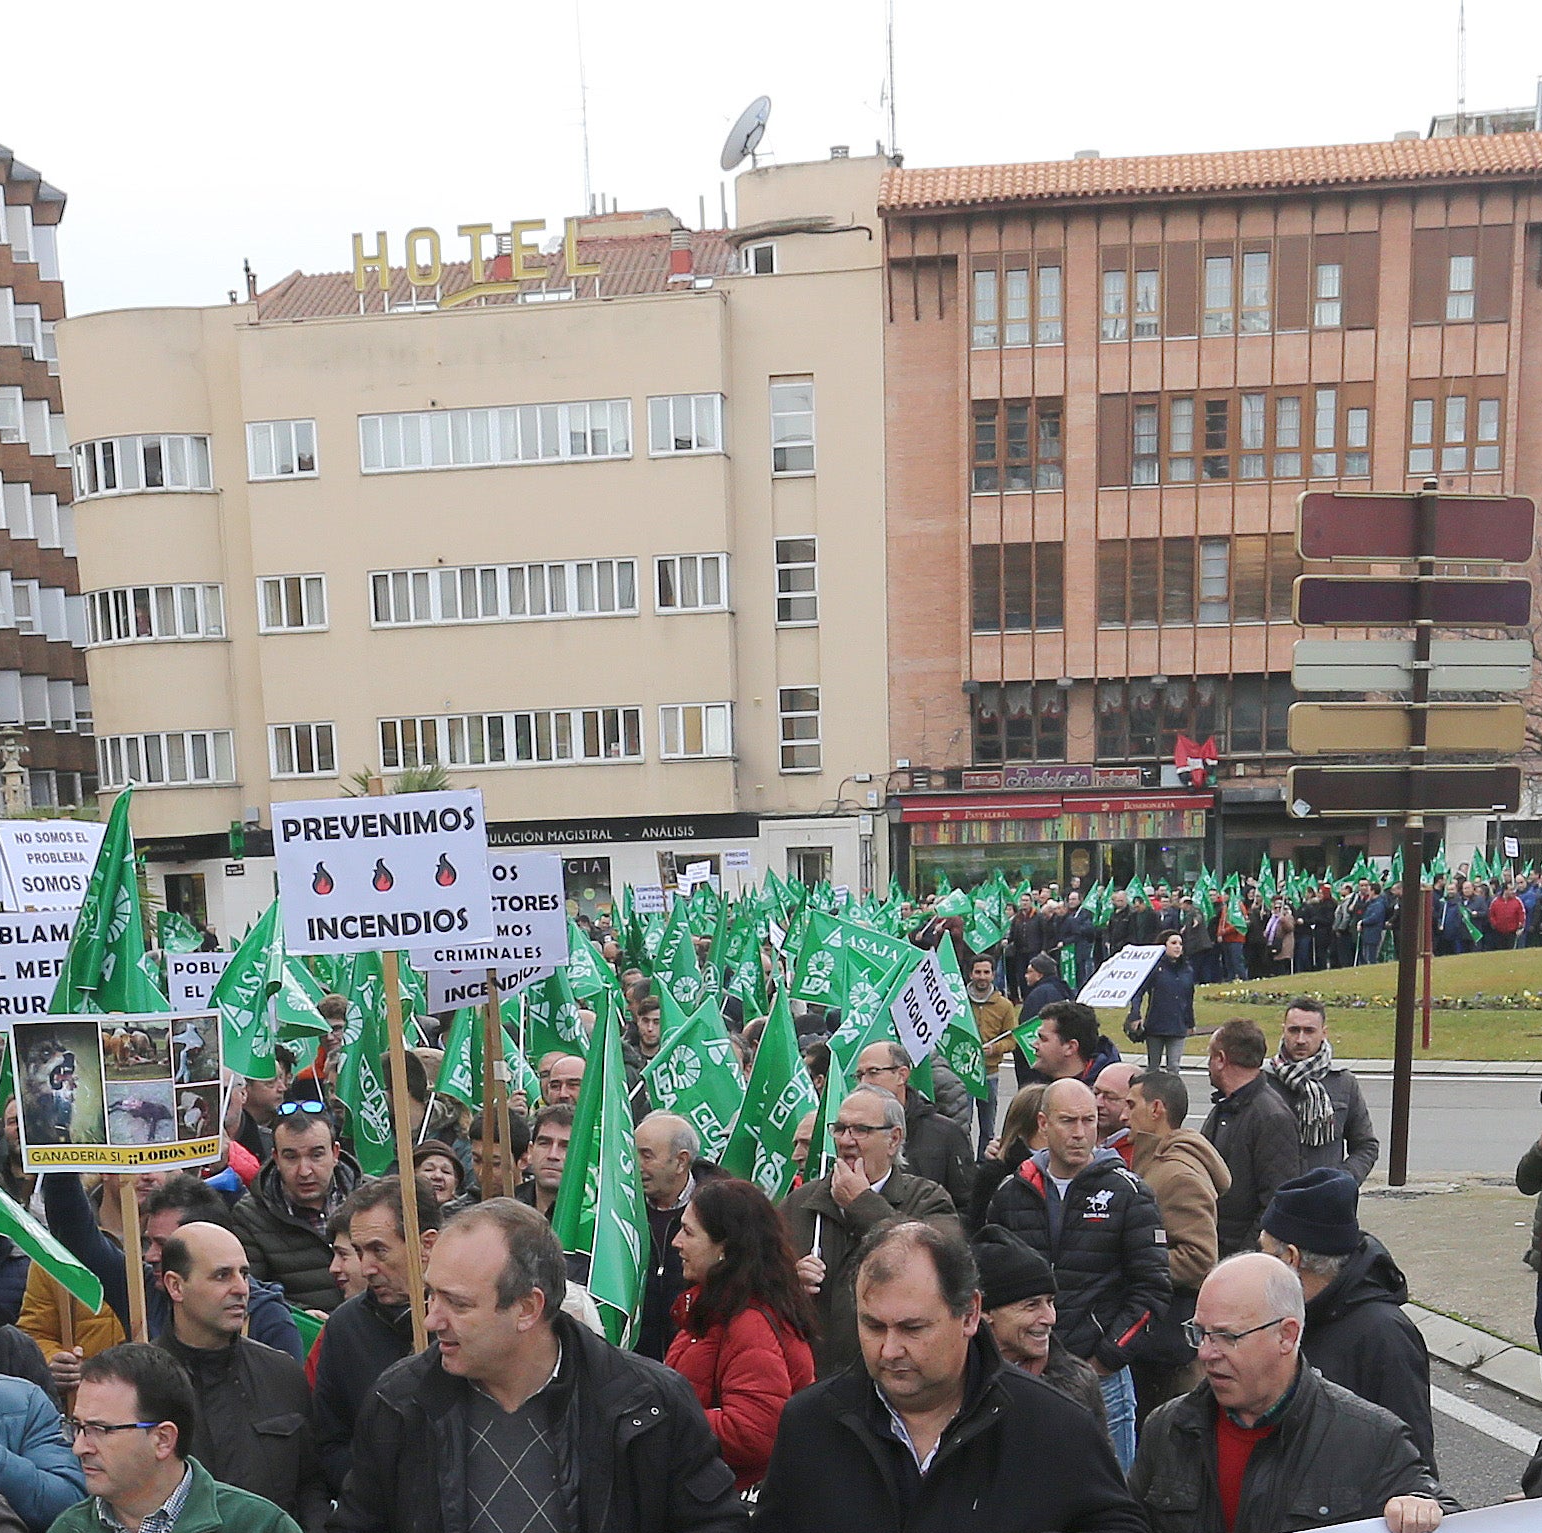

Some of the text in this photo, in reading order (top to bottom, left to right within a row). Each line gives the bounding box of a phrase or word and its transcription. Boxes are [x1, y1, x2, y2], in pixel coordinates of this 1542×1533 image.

[351, 217, 601, 292] HOTEL
[282, 806, 475, 844] PREVENIMOS
[15, 831, 89, 844] NO SOMOS EL
[488, 825, 695, 844] ULACIÓN MAGISTRAL ANÁLISIS
[491, 865, 518, 881] OS
[567, 860, 602, 875] CIA
[22, 875, 82, 893] SOMOS
[307, 907, 469, 942] INCENDIOS
[496, 924, 532, 937] MOS
[434, 946, 542, 962] CRIMINALES
[661, 921, 689, 970] ASAJA
[843, 934, 899, 960] ASAJA
[1119, 950, 1158, 960] CIMOS
[174, 961, 228, 975] POBL
[1107, 970, 1139, 980] NTOS
[184, 985, 205, 999] EL
[799, 976, 831, 996] UPA
[920, 958, 952, 1023] PRECIOS
[1095, 989, 1128, 999] IDAD
[903, 986, 934, 1046] DIGNOS
[652, 1062, 678, 1110] UPA
[31, 1141, 216, 1165] GANADERÍA SI, ¡¡LOBOS NO!!
